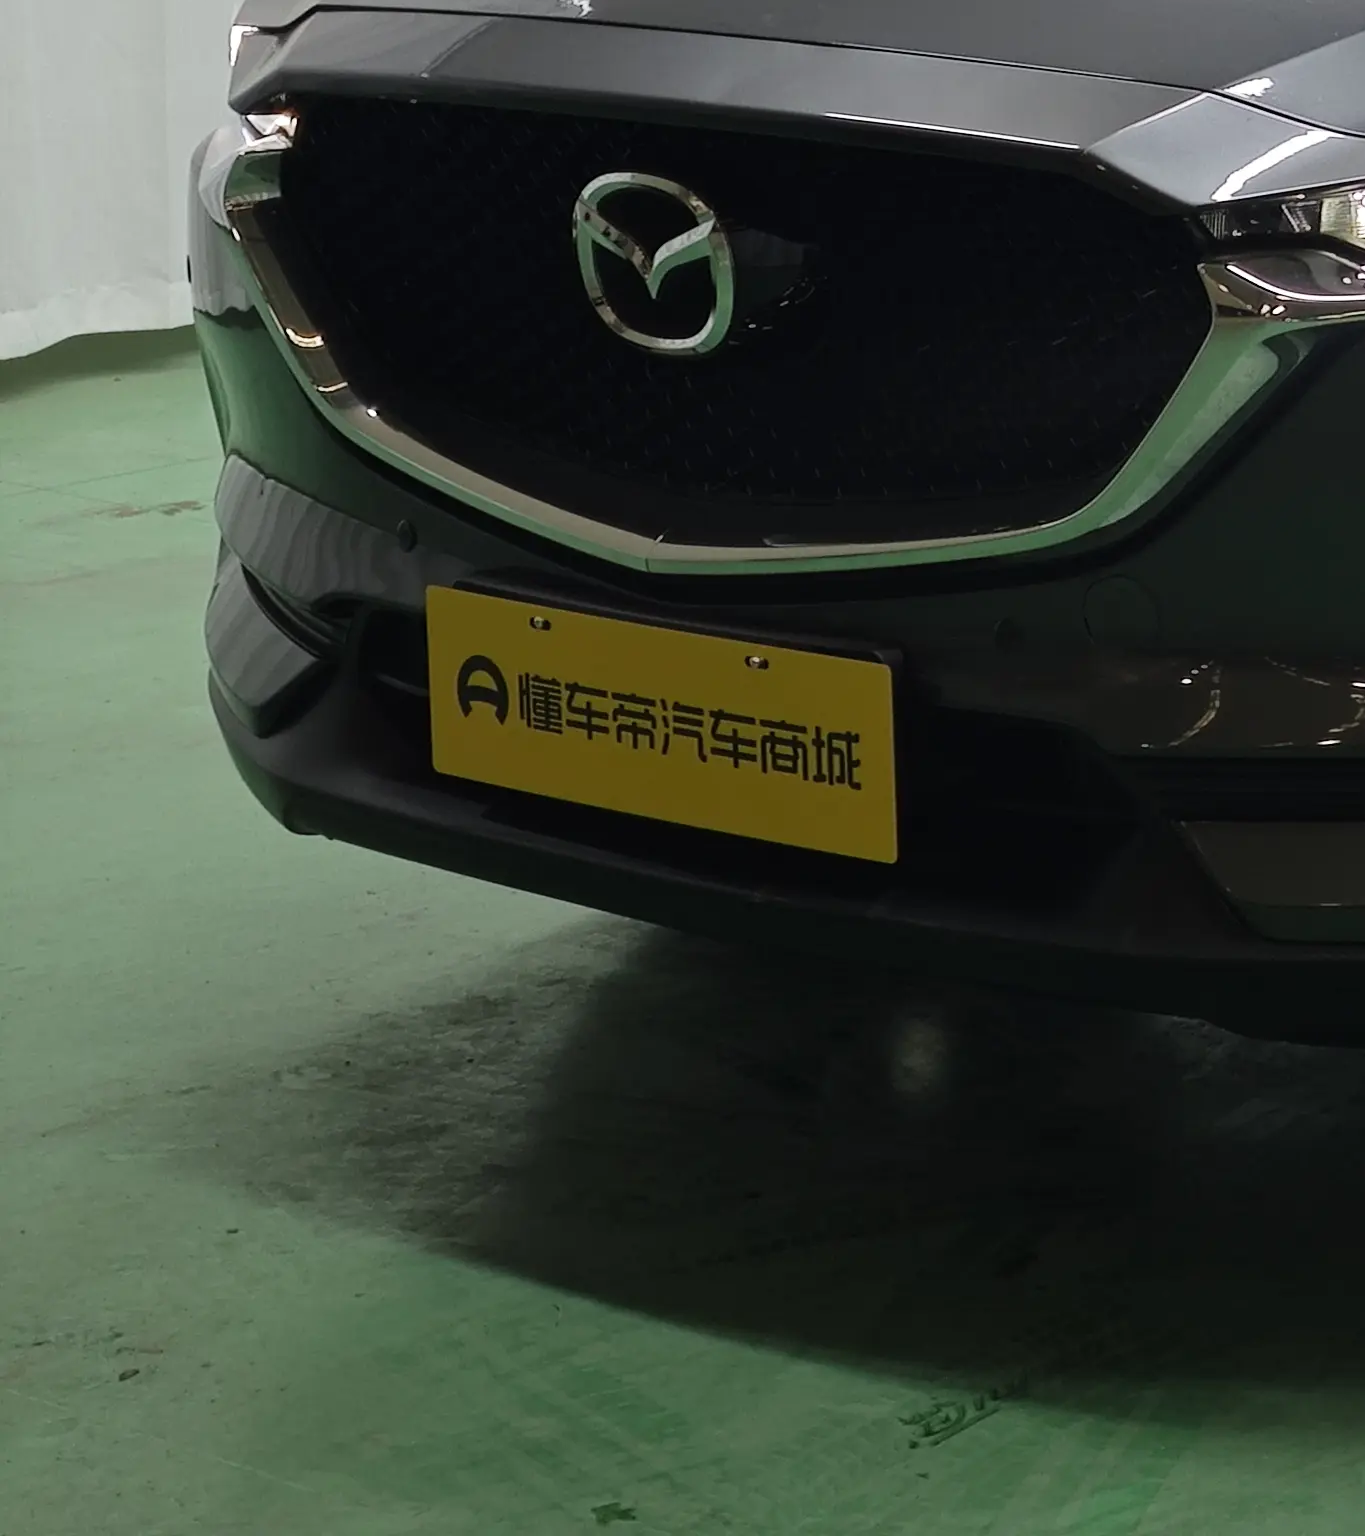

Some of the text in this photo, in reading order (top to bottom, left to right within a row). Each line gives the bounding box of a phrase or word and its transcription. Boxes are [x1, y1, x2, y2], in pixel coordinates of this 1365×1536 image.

[517, 672, 862, 790] 懂车帝汽车商城
